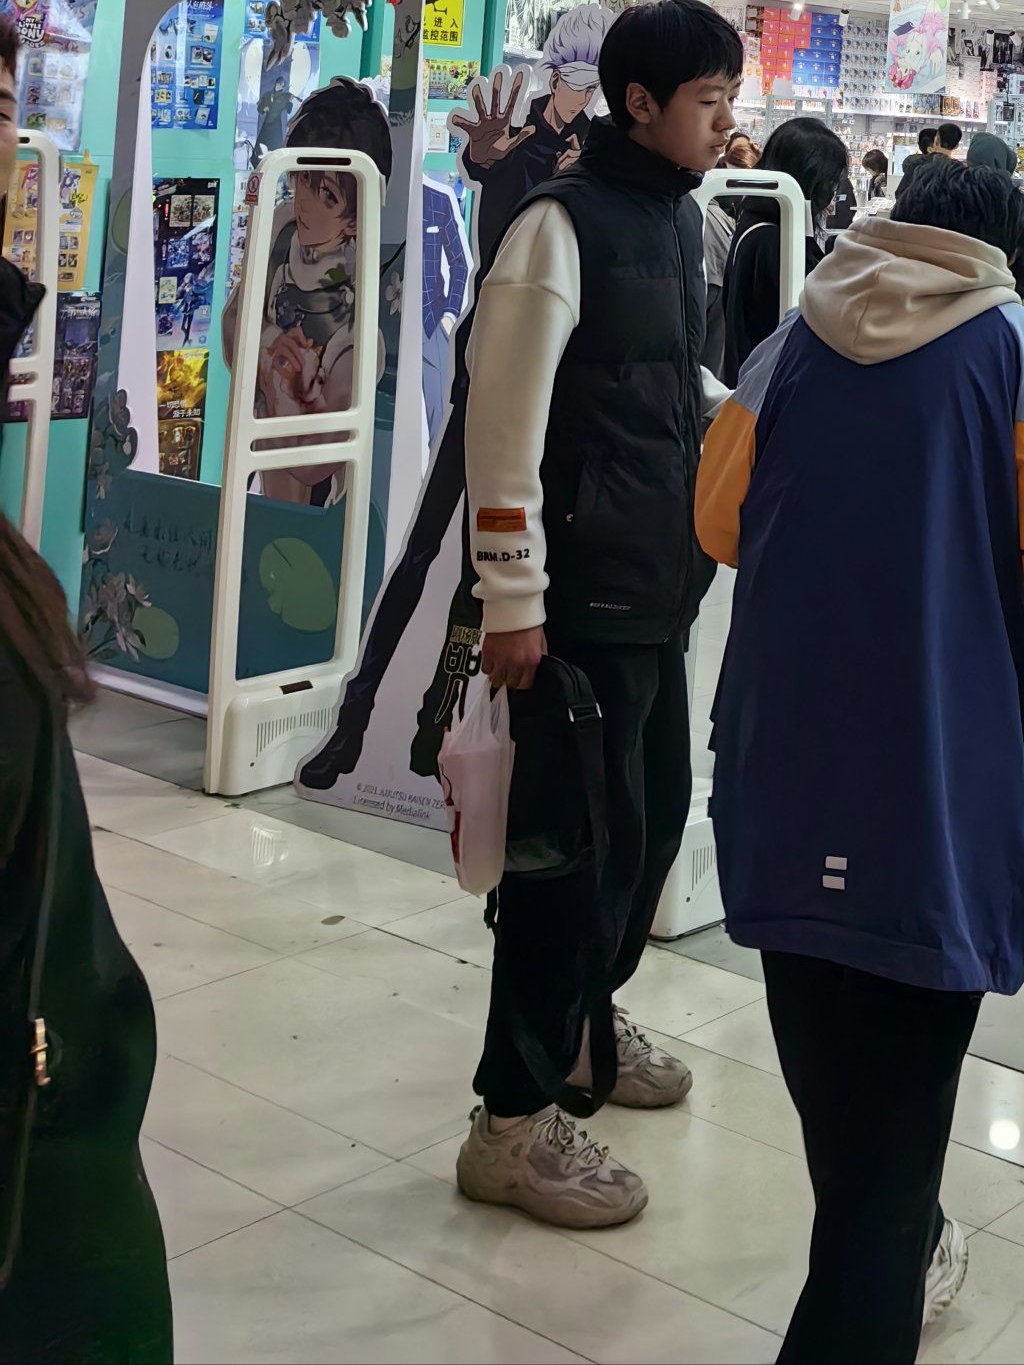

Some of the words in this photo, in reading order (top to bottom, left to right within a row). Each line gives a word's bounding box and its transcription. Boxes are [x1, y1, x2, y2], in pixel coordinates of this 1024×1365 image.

[19, 22, 42, 30] LITTLE
[423, 30, 458, 42] 监控范围
[353, 795, 385, 810] Licensed
